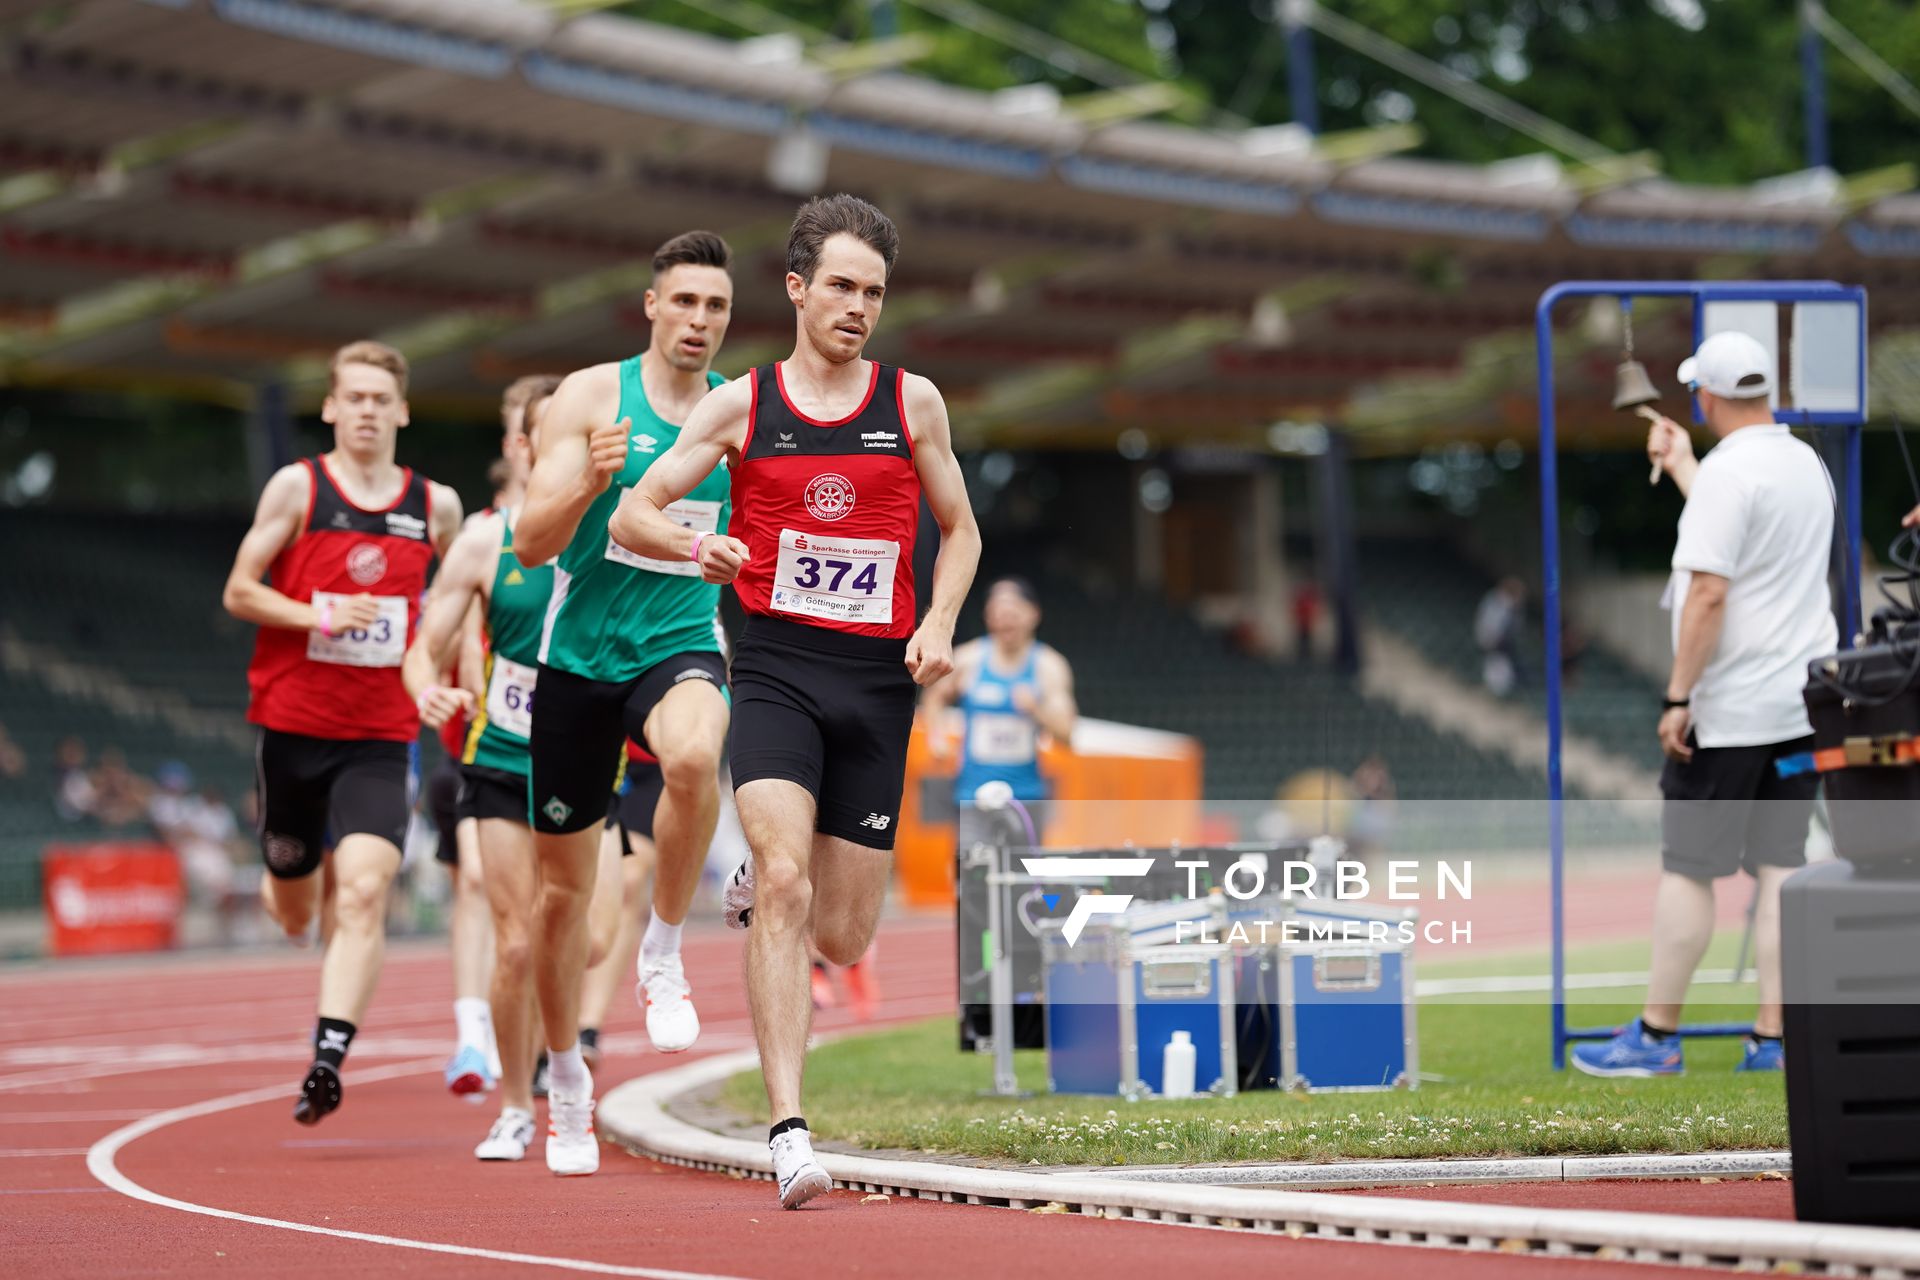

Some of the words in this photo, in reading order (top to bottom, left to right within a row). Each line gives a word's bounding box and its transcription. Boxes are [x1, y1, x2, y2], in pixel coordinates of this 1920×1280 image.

[811, 545, 850, 554] Sparkasse
[852, 548, 886, 556] Göttingen
[794, 556, 877, 595] 374
[805, 596, 846, 610] Göttingen
[847, 604, 865, 612] 2021
